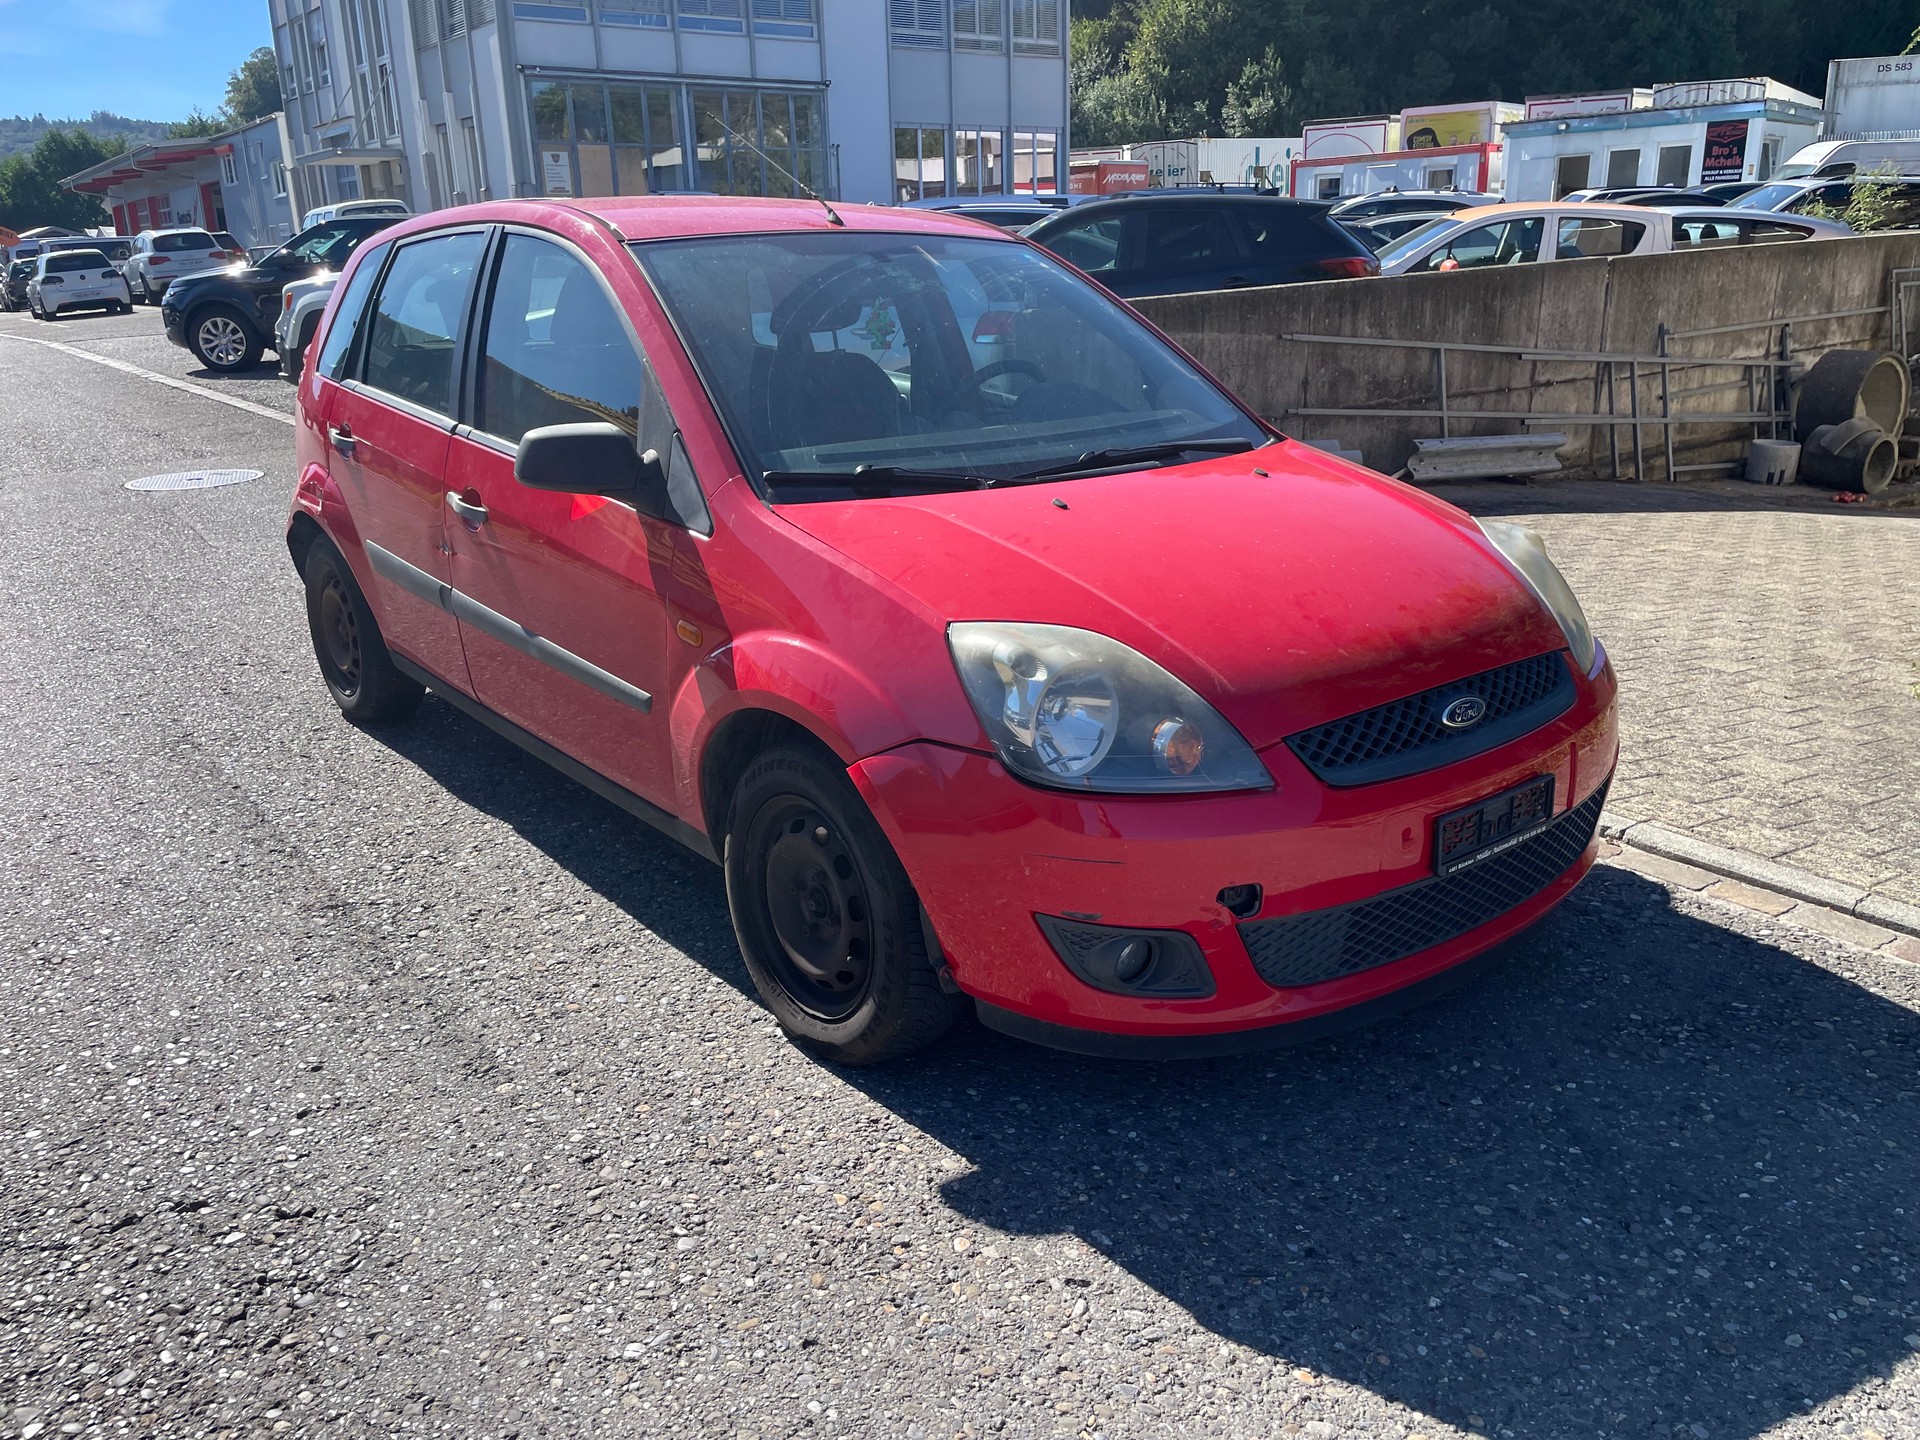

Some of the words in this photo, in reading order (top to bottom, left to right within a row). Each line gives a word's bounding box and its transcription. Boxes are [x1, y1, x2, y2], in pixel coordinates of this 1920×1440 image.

[1877, 63, 1892, 73] DS
[1895, 62, 1913, 72] 583
[1705, 155, 1743, 168] Mcheik
[1149, 164, 1187, 178] reier
[1455, 702, 1480, 722] Ford
